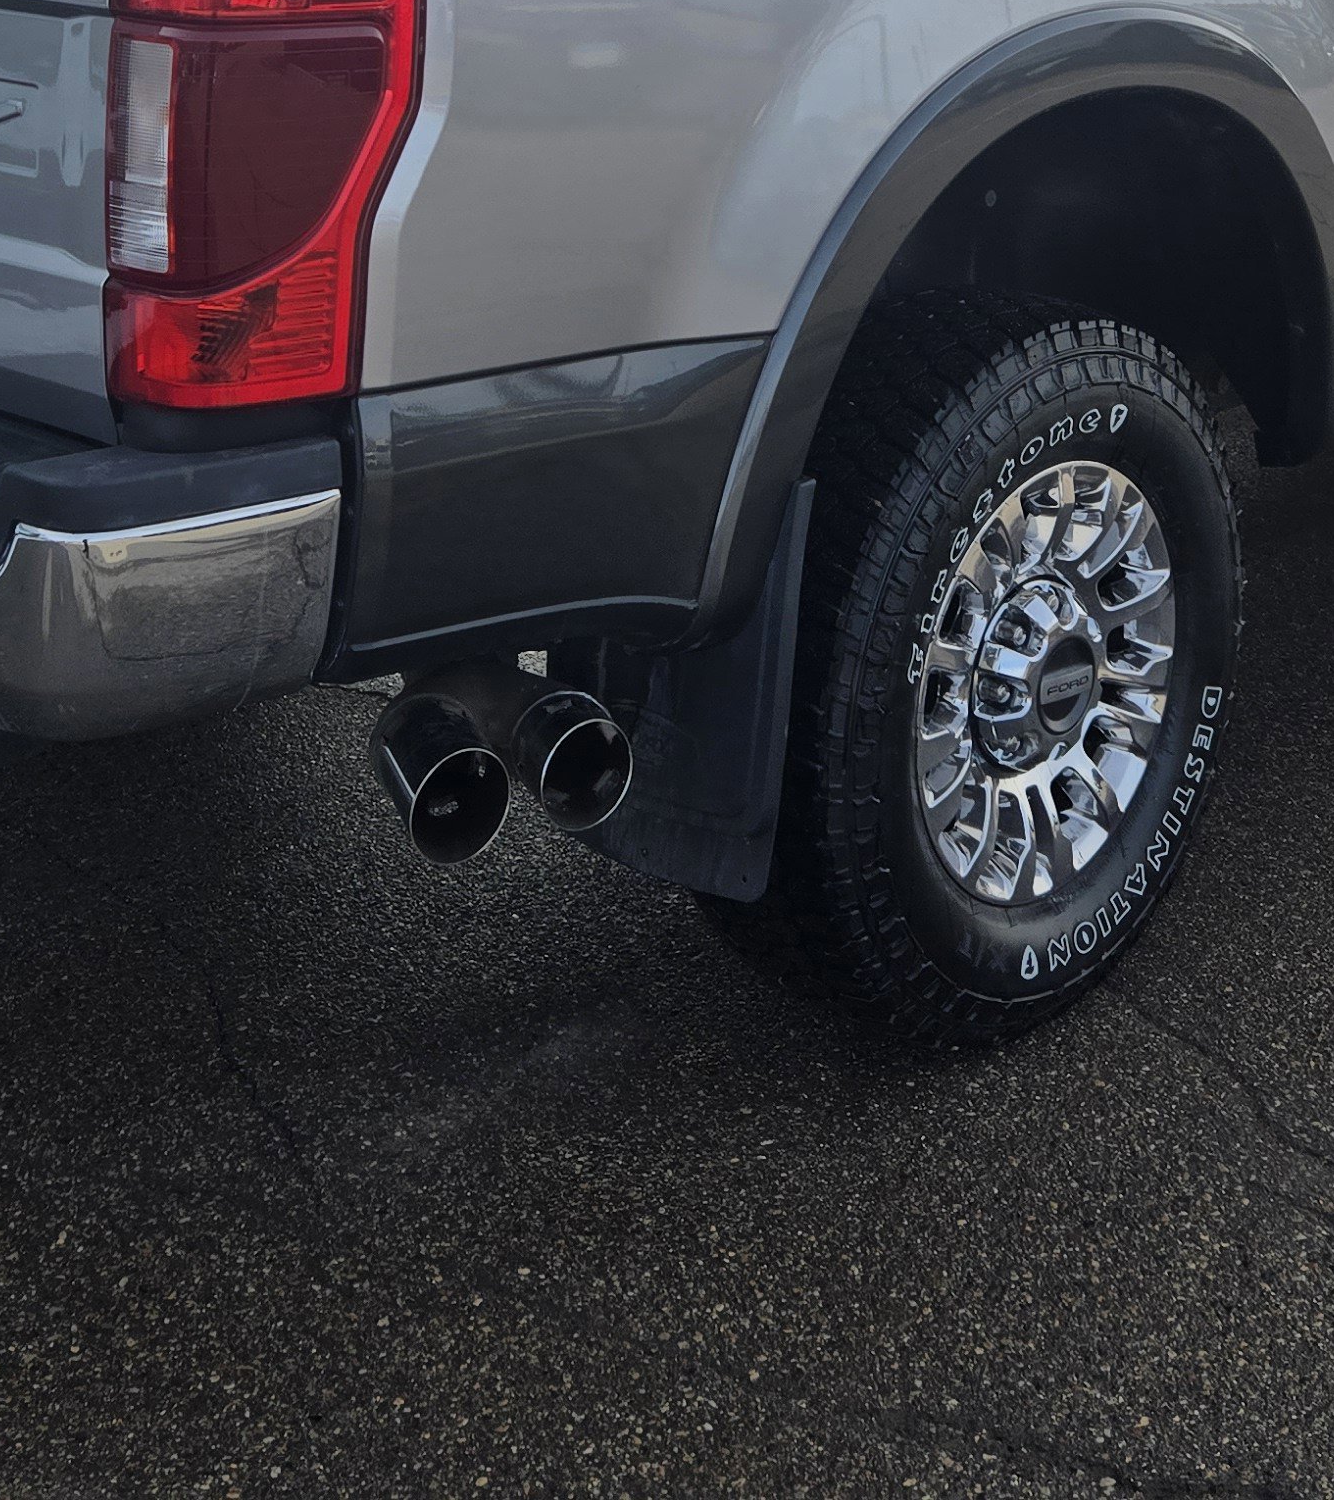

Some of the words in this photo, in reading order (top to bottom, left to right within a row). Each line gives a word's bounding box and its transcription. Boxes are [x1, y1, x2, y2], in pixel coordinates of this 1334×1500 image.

[907, 408, 1102, 685] Firestone
[1047, 675, 1089, 696] FORD
[1047, 685, 1223, 972] DESTINATION
